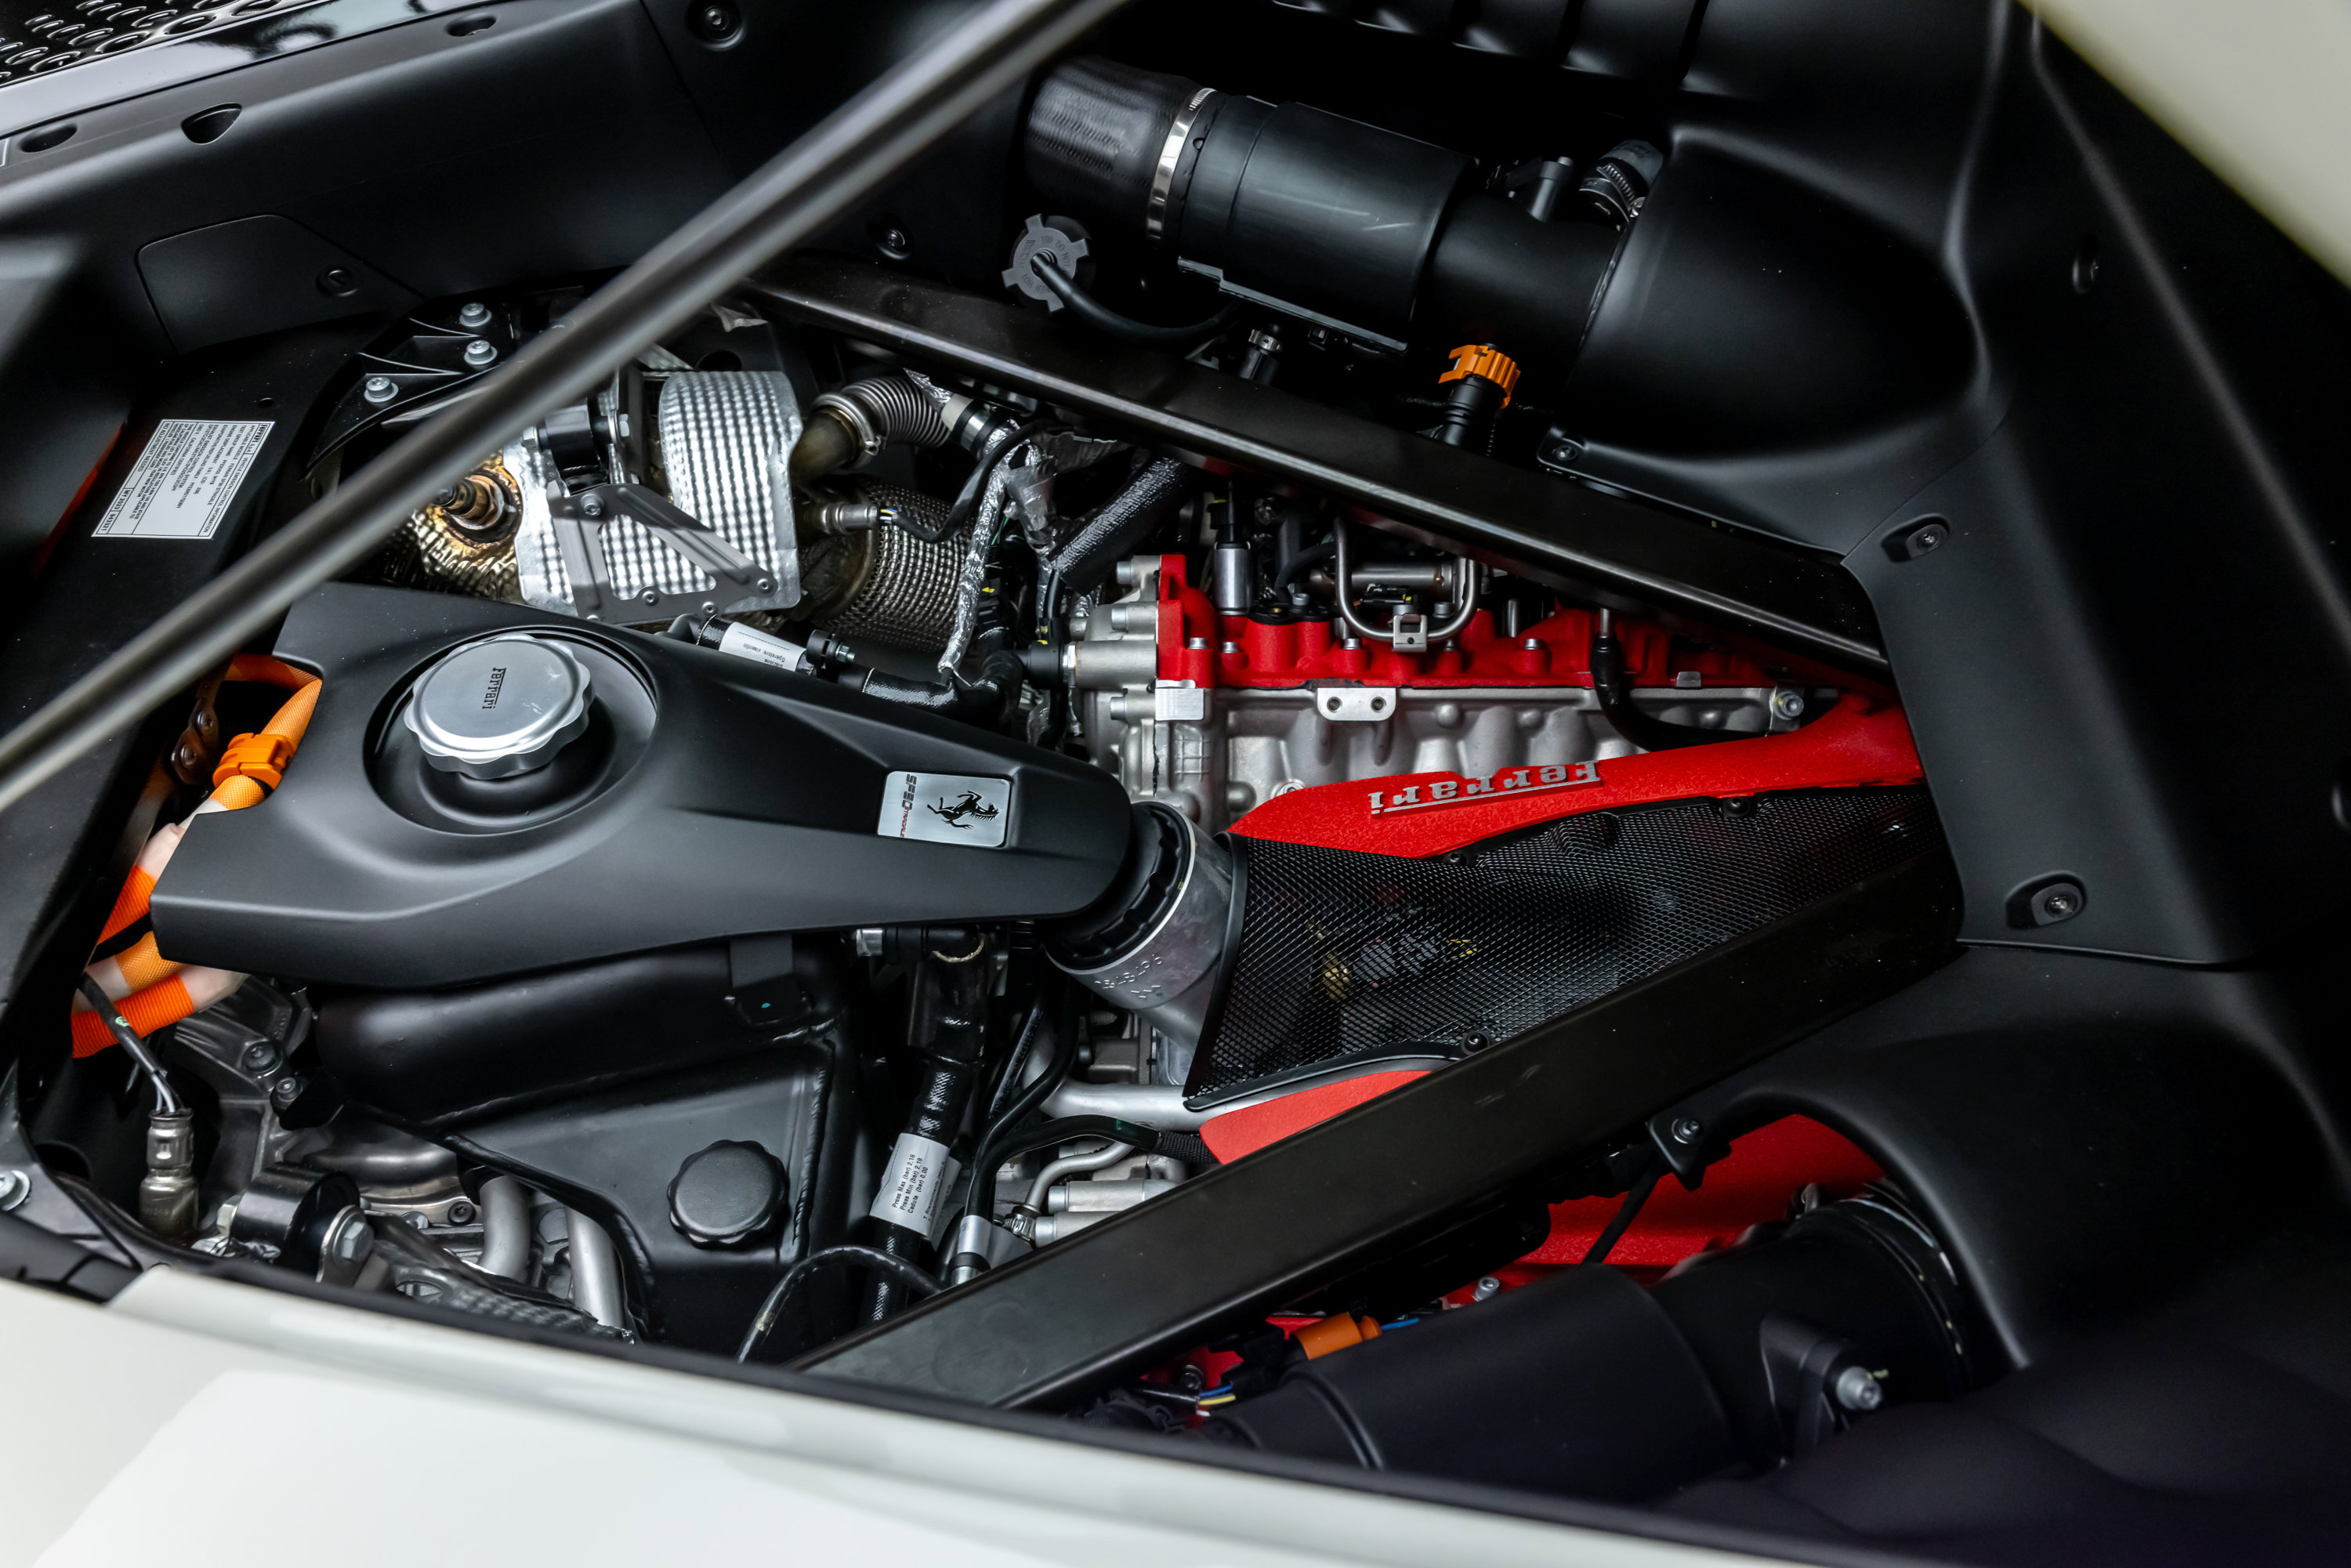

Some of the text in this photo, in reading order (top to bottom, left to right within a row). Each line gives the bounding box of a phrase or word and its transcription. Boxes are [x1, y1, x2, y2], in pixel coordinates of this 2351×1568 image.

[172, 428, 187, 446] CALIFORNIA
[178, 431, 190, 443] VEHICLE
[225, 425, 237, 437] ENGINE
[230, 433, 241, 446] GROUP
[239, 425, 256, 445] APPLICABLE
[251, 424, 267, 443] Ferrari
[146, 429, 167, 454] ADJUSTMENT
[148, 422, 179, 468] VEHICLES PASSENGER CARS
[180, 437, 197, 457] CALIFORNIA
[210, 437, 230, 463] DISPLACEMENT
[168, 444, 182, 461] CONFORMS
[177, 424, 219, 487] EXHAUST EMISSION CONTROL SYSTEM
[224, 446, 234, 456] NAME
[231, 445, 245, 459] MODELS
[136, 455, 151, 472] NEEDED
[153, 458, 164, 469] MODEL
[169, 458, 185, 475] CERTIFIED
[192, 466, 204, 479] FAMILY
[221, 462, 235, 477] FERRARI
[147, 469, 157, 477] YEAR
[136, 485, 147, 497] MOTOR
[143, 472, 161, 493] REGULATIONS
[113, 498, 125, 509] 2023
[132, 494, 147, 513] APPLICABLE
[201, 457, 248, 533] VEHICLE EMISSION CONTROL INFORMATION
[206, 487, 222, 505] STRADALE
[100, 513, 116, 531] 943321
[133, 509, 143, 519] STATE
[482, 668, 507, 709] Ferrari
[902, 773, 918, 810] SF90
[1367, 760, 1600, 815] Ferrari
[900, 806, 910, 838] STRADALE
[892, 1193, 901, 1208] Press
[897, 1181, 906, 1192] Max
[902, 1168, 911, 1179] (bar)
[900, 1196, 909, 1211] Press
[905, 1184, 914, 1194] Min
[910, 1171, 919, 1183] (bar)
[907, 1195, 918, 1213] Caduta
[916, 1179, 925, 1192] (bar)
